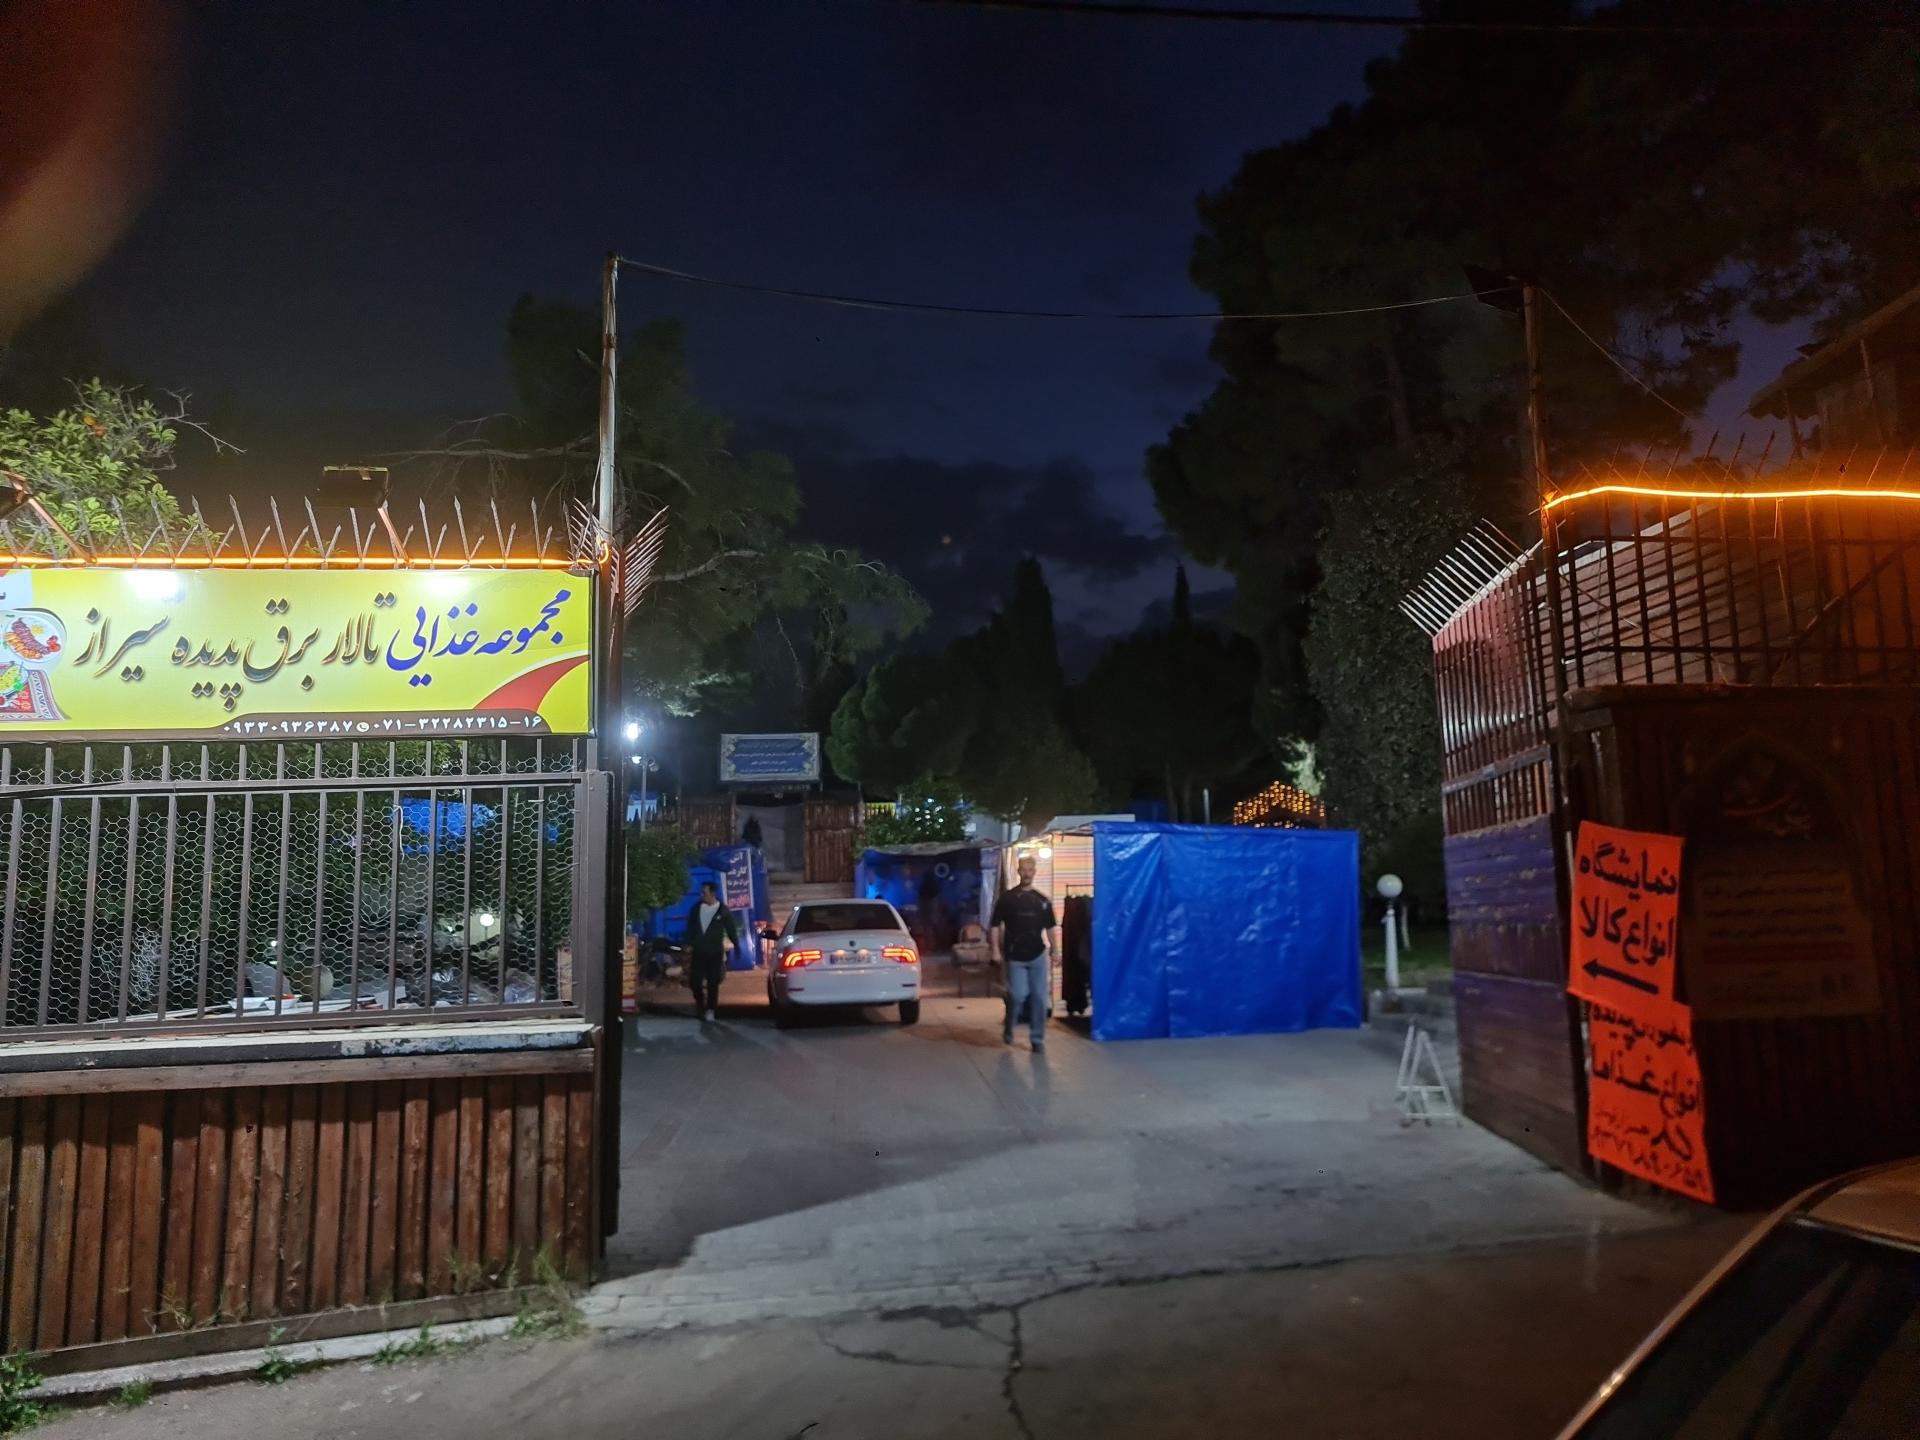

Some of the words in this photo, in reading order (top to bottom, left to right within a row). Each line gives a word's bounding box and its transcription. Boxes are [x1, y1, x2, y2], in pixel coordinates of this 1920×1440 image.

[242, 598, 321, 690] برق
[321, 591, 396, 664] تالار
[386, 602, 479, 687] غذایی
[474, 589, 572, 655] مجموعه
[170, 635, 243, 712] پدیده
[223, 720, 353, 735] ۰۹۳۳۰۹۳۶۳۸۷
[1579, 841, 1678, 901] نمایشگاه
[1580, 896, 1627, 944] کالا
[1622, 910, 1674, 967] انواع
[1660, 1068, 1706, 1120] انواع
